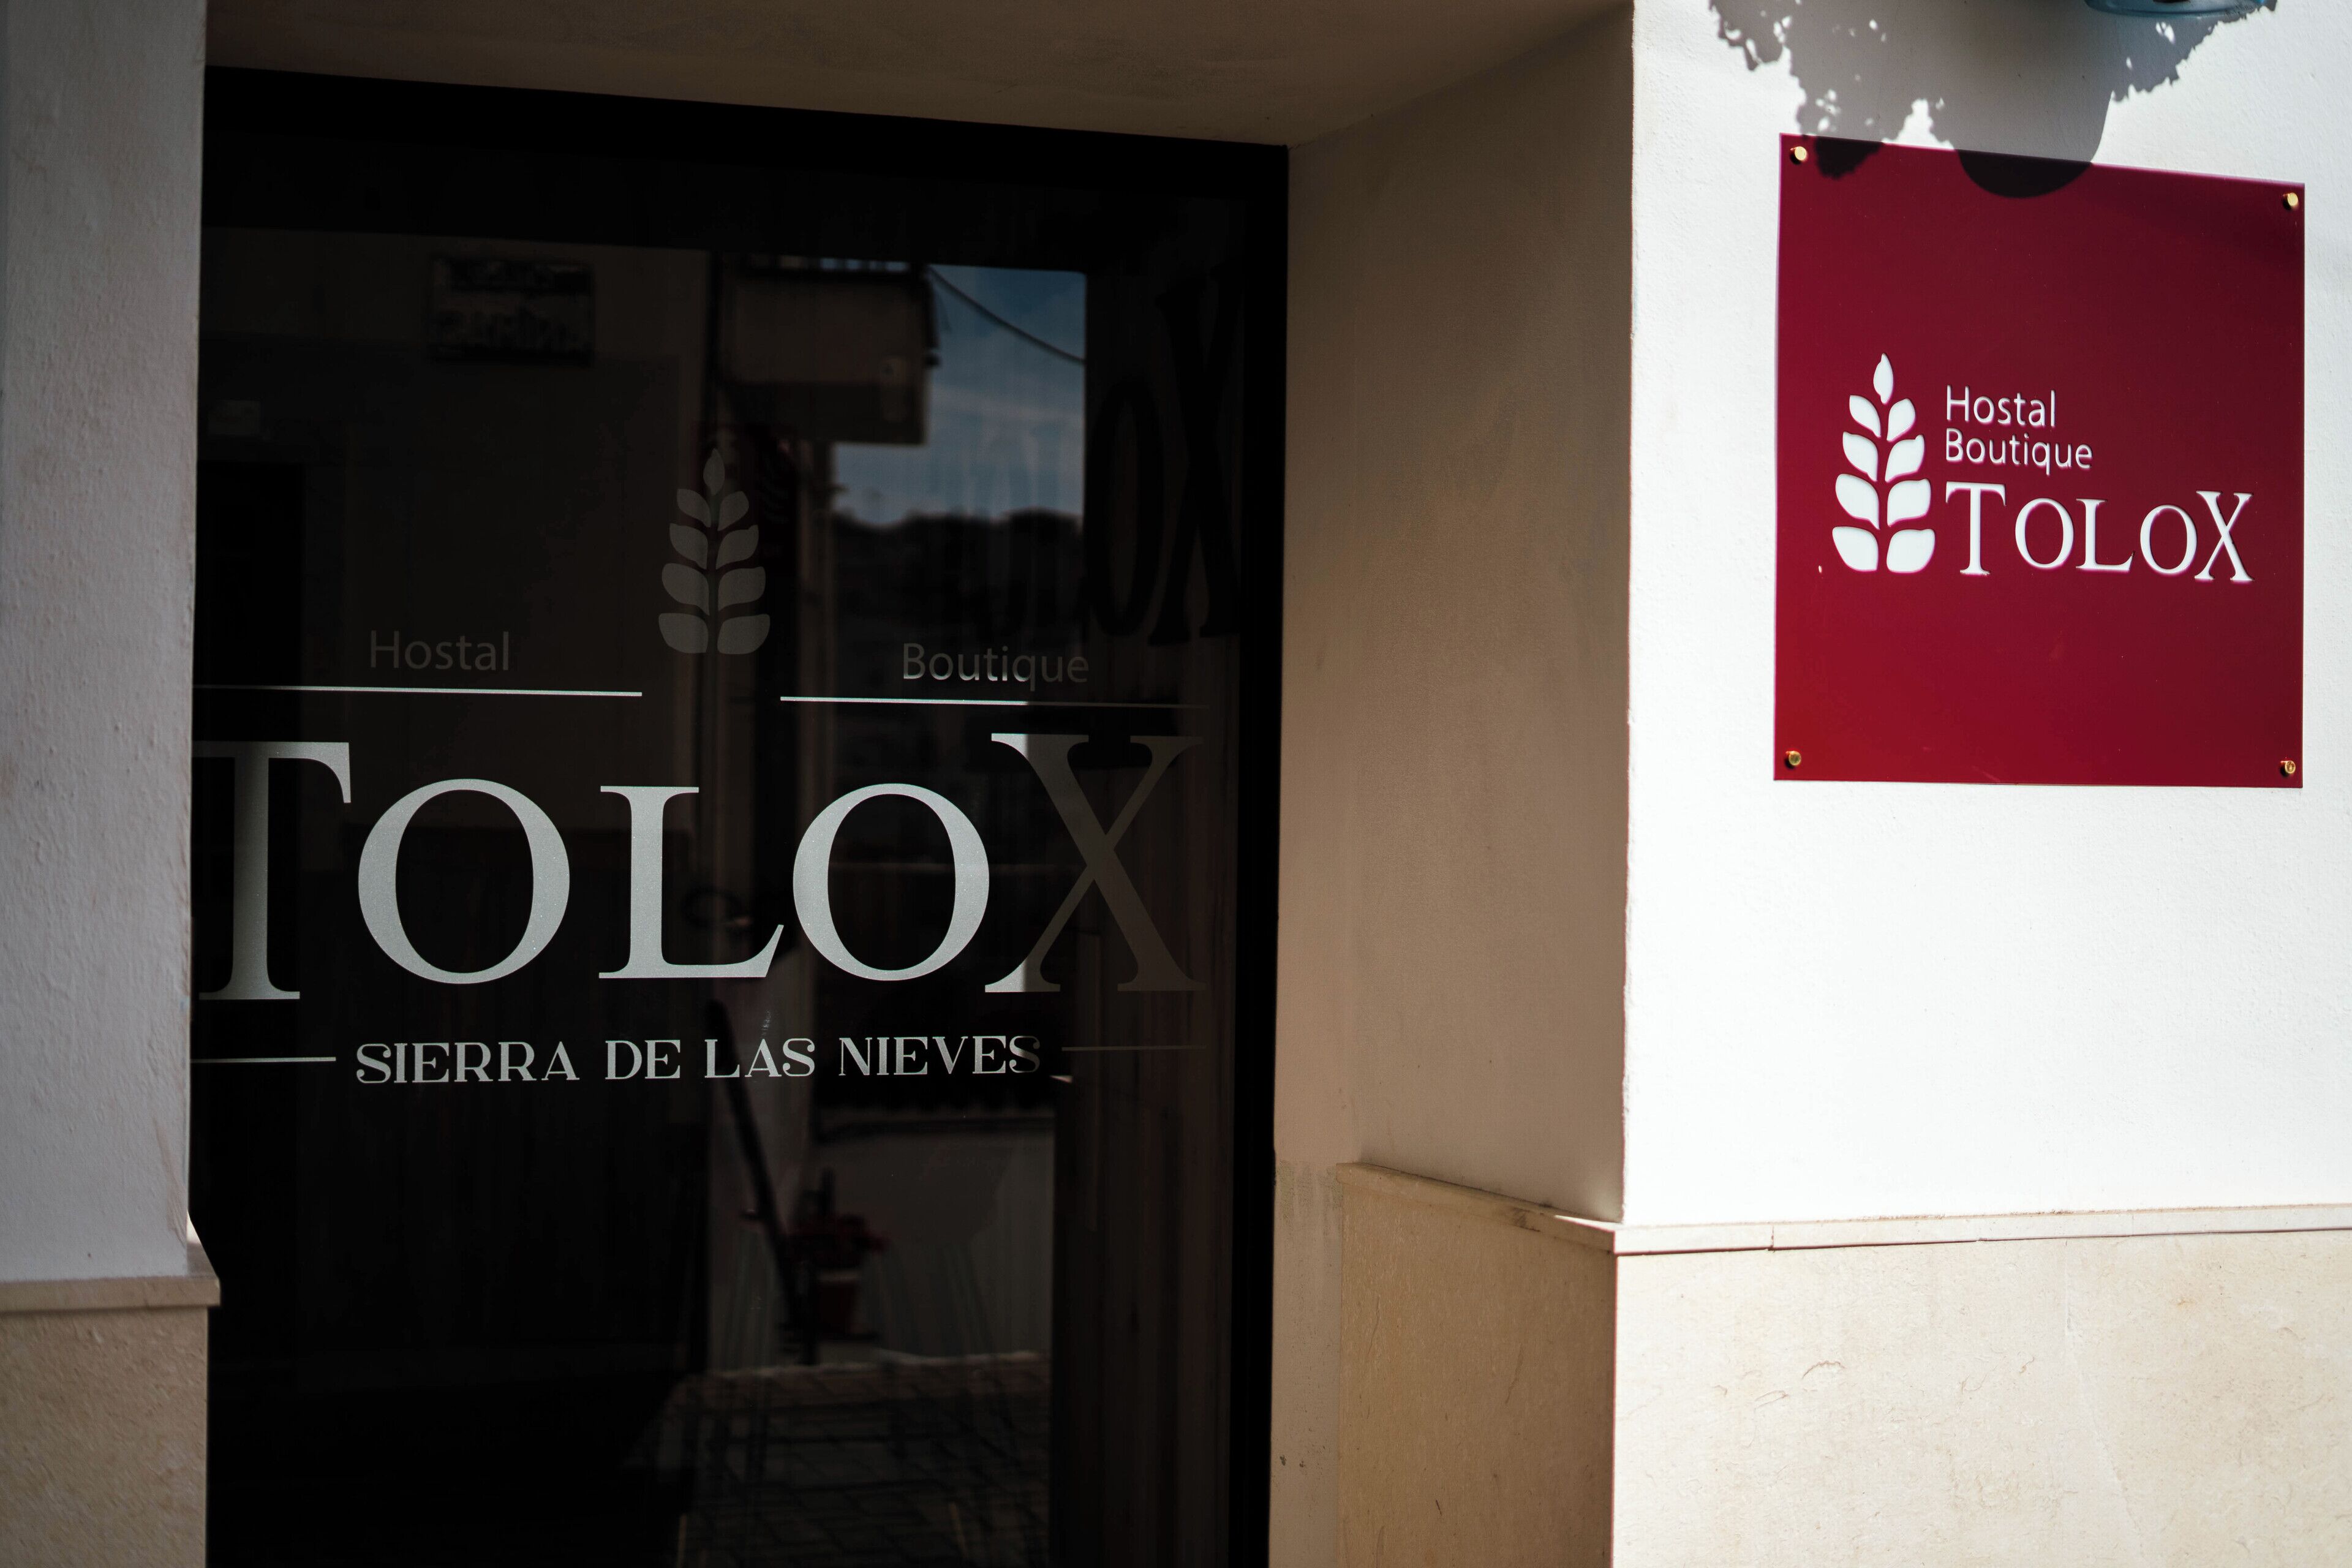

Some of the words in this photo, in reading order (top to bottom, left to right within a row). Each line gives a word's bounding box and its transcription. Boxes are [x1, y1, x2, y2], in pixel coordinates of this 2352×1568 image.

[1947, 385, 2056, 427] Hostal
[1945, 428, 2093, 476] Boutique
[1945, 481, 2253, 582] TOLOX
[370, 630, 510, 671] Hostal
[902, 642, 1090, 692] Boutique
[192, 733, 1206, 1001] TOLOX
[355, 1041, 580, 1084] SIERRA
[604, 1039, 681, 1080] DE
[704, 1038, 815, 1079] LAS
[838, 1035, 1042, 1077] NIEVES
